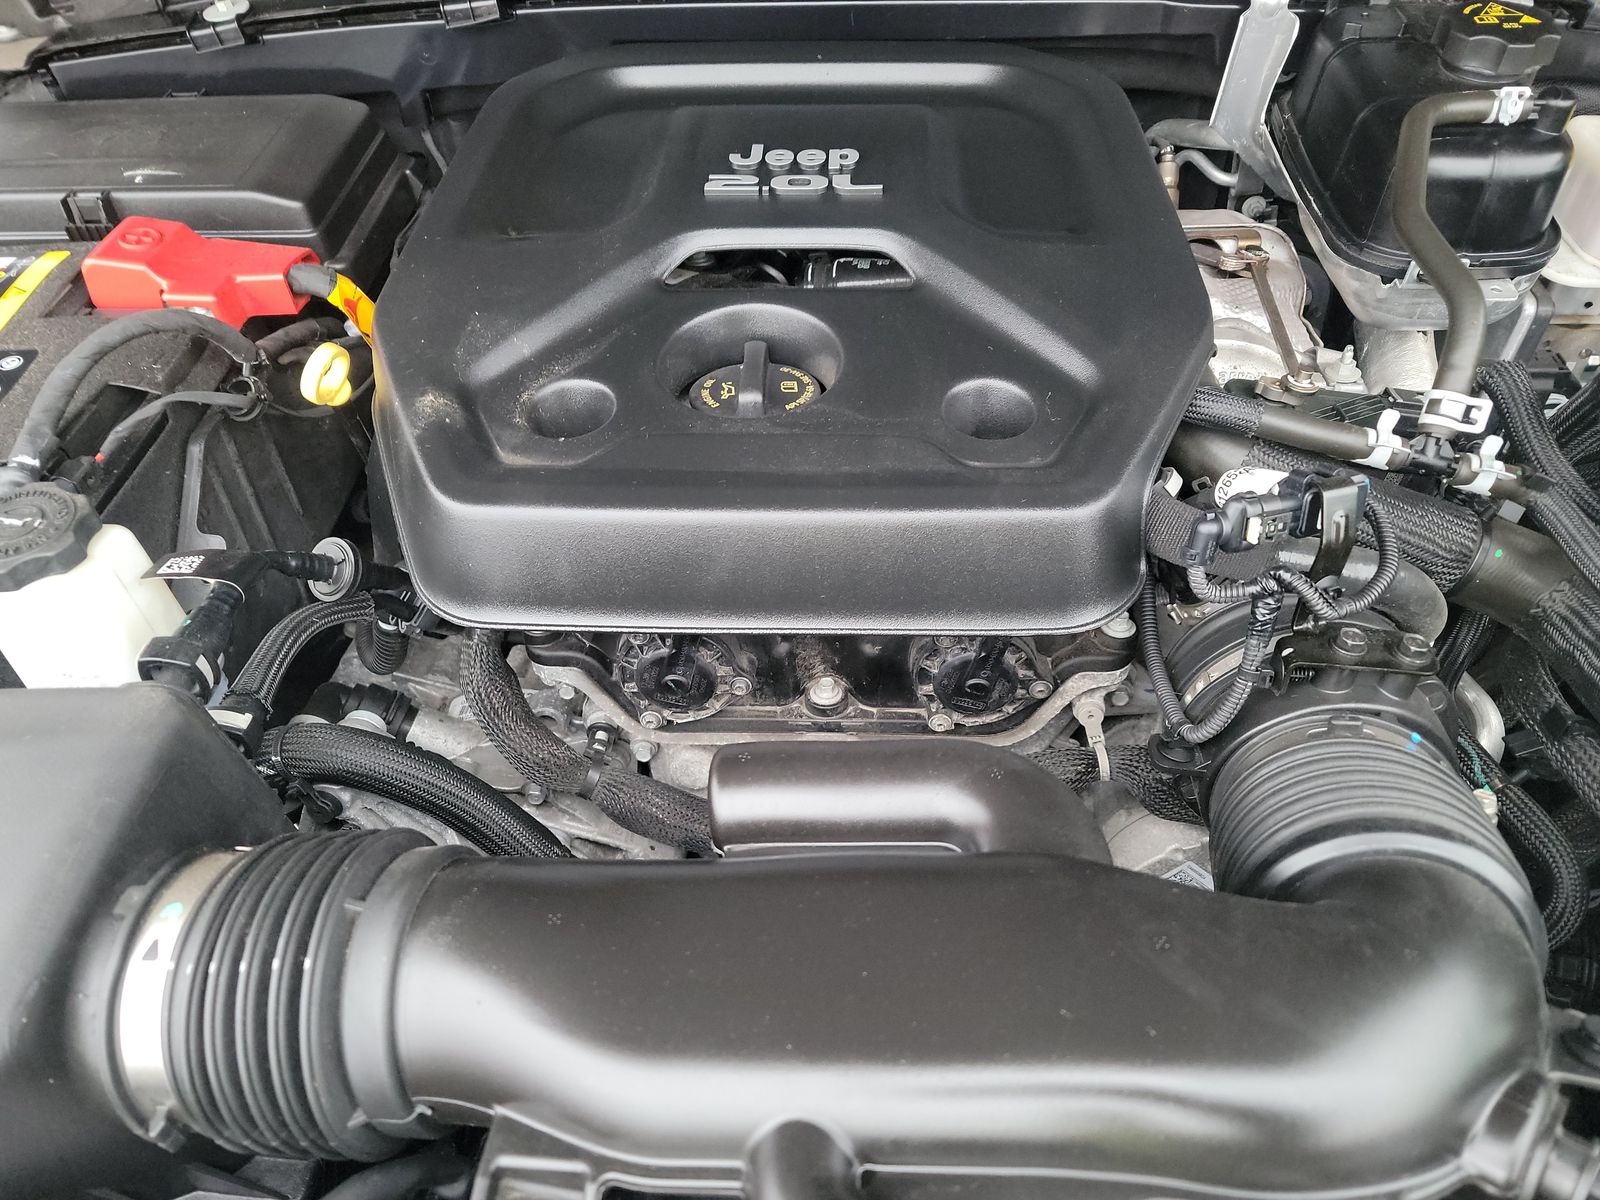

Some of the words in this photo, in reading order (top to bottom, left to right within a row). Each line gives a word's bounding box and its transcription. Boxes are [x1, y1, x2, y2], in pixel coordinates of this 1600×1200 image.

[729, 144, 859, 173] Jeep
[704, 174, 883, 195] 2.0L
[703, 378, 717, 388] OIL
[701, 388, 720, 408] ENGINE
